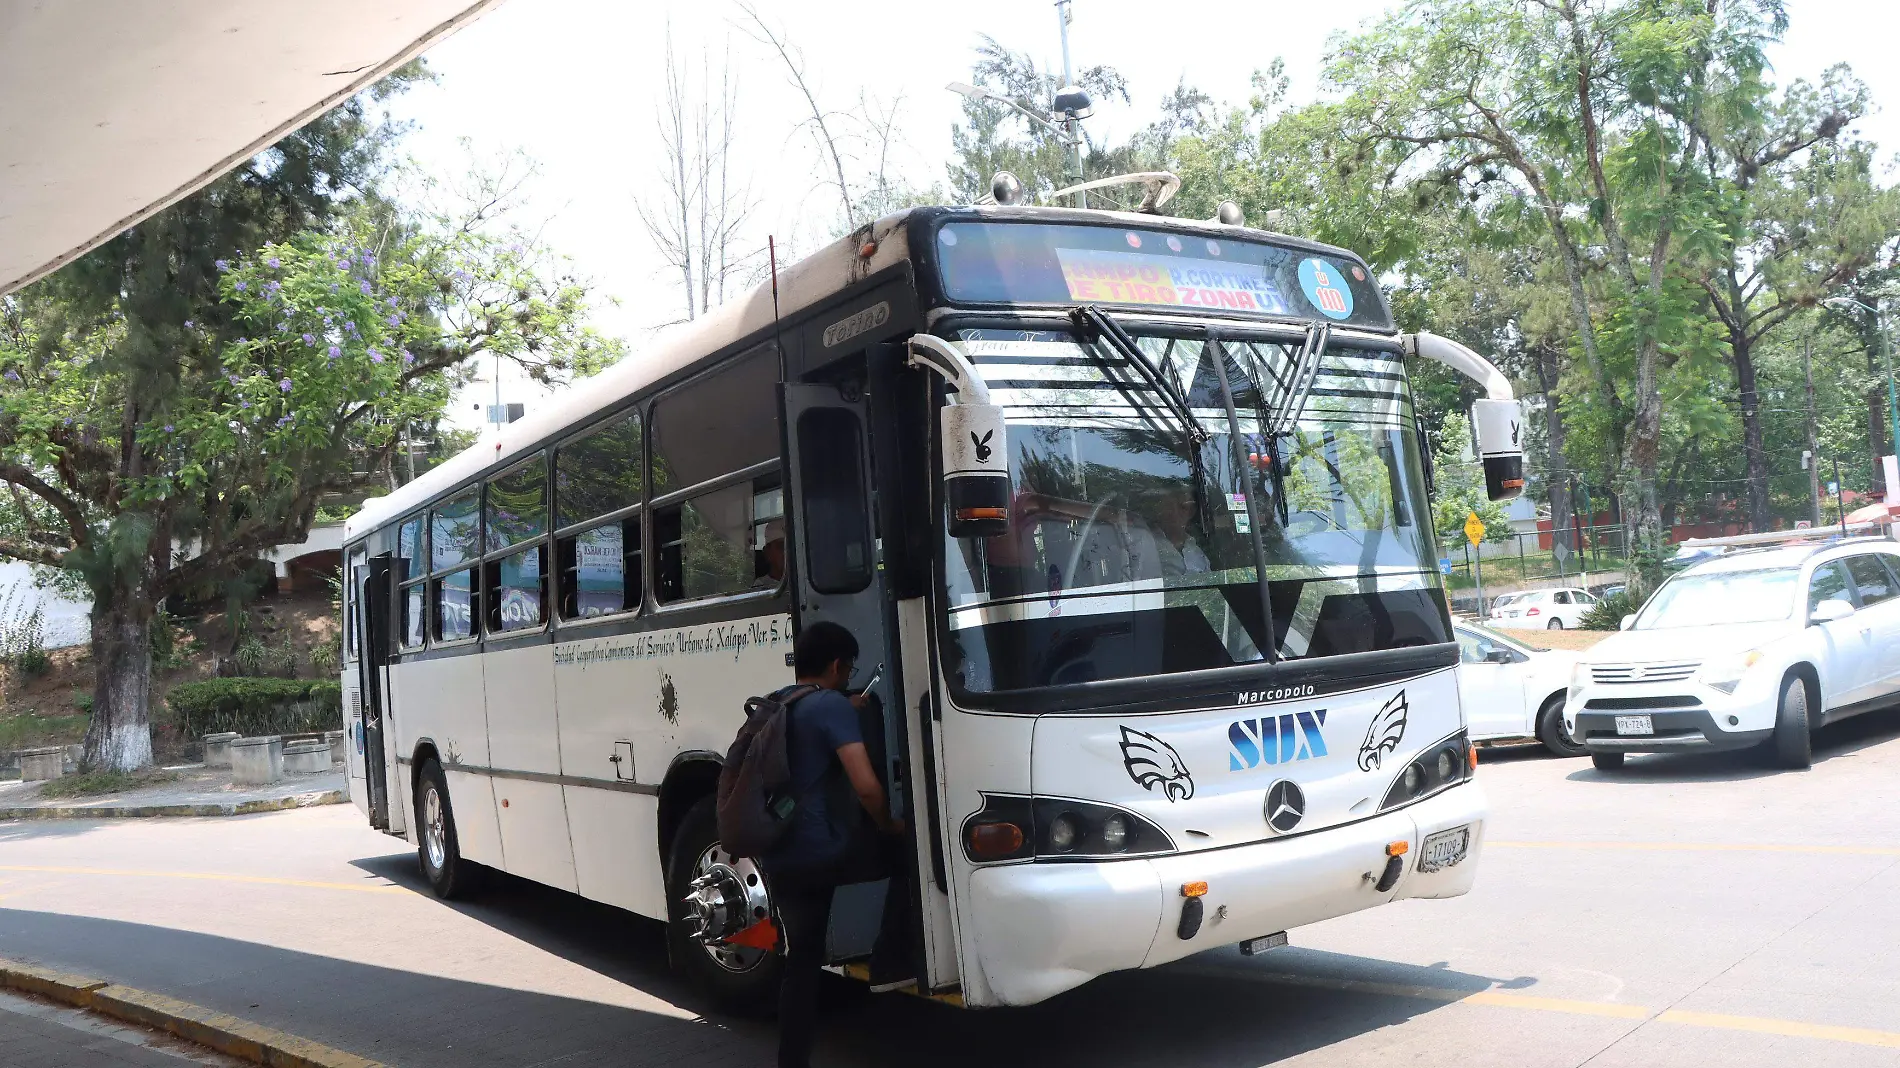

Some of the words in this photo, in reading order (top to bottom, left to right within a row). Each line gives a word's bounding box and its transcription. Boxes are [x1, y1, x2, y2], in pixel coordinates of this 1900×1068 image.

[1103, 281, 1176, 302] TIRO
[1177, 287, 1256, 309] ZONA
[1316, 287, 1346, 312] 110
[647, 635, 675, 657] Servicio
[705, 629, 713, 652] de
[770, 620, 780, 643] S.
[1238, 685, 1314, 705] Marcopolo
[1228, 709, 1328, 772] SUX
